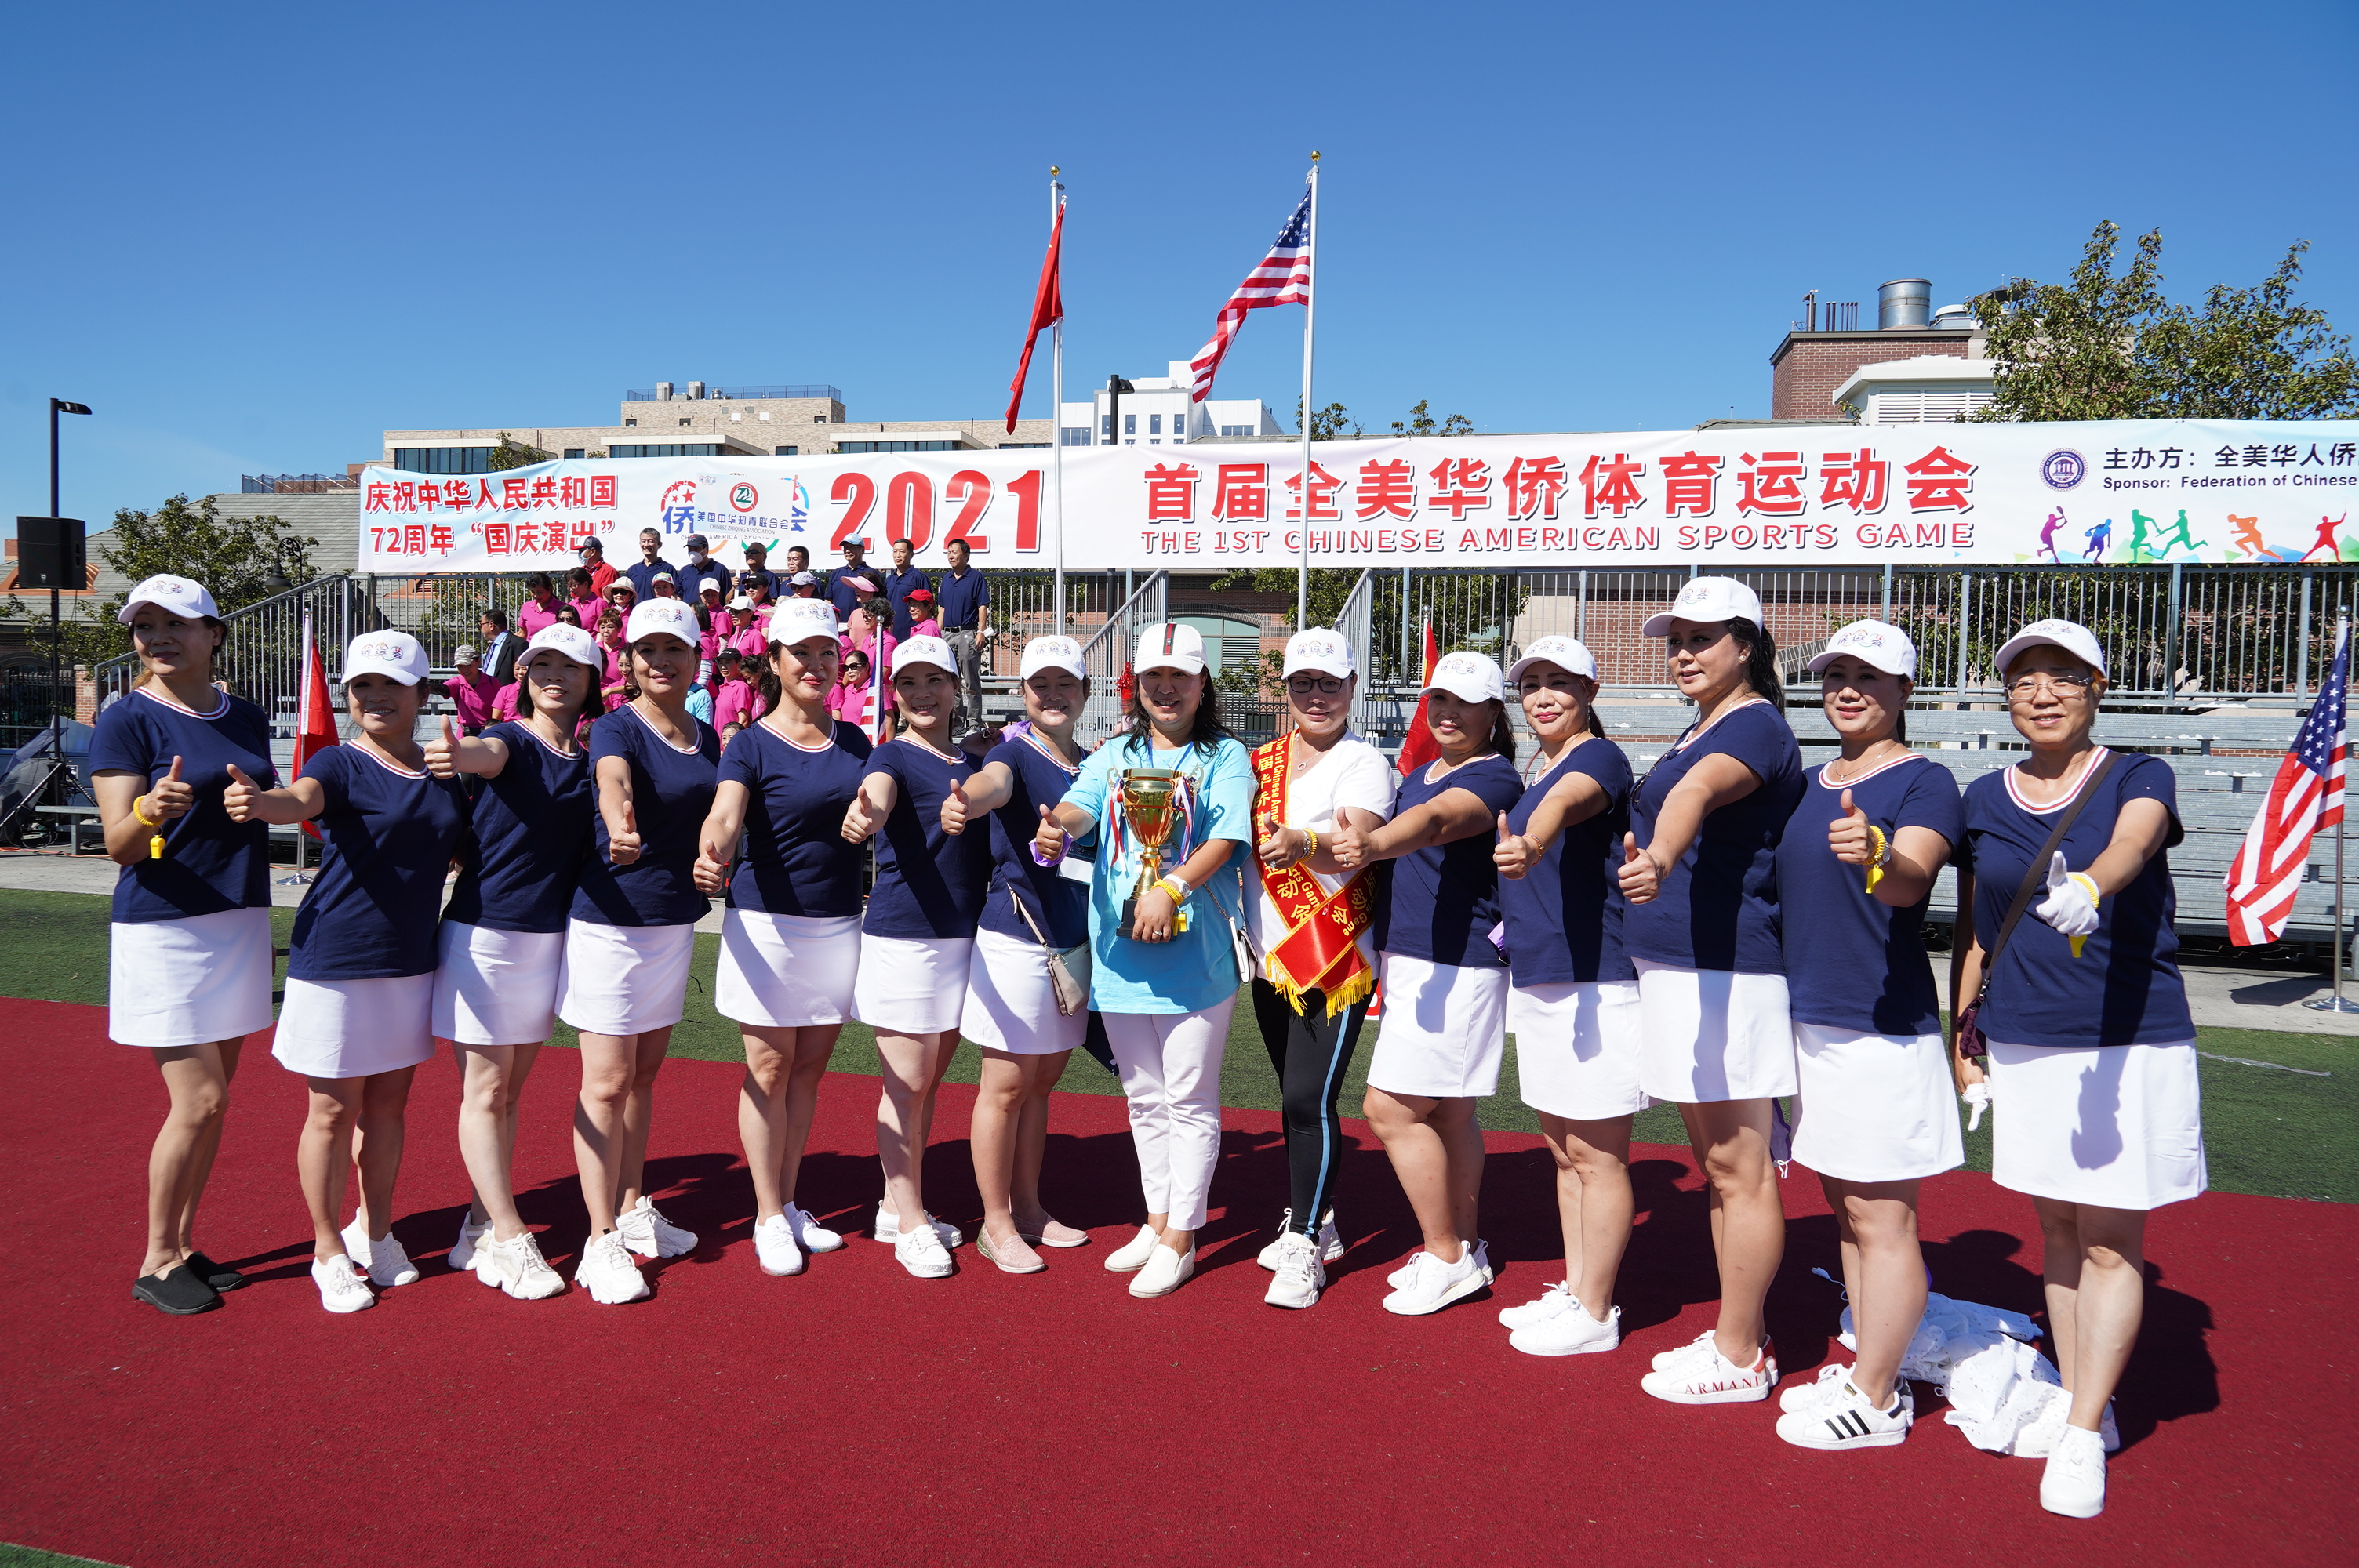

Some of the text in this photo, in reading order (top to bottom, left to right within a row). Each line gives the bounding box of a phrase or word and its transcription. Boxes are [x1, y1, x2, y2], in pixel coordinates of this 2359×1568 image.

[365, 474, 618, 513] 庆祝中华人民共和国
[1144, 445, 1974, 523] 首届全美华侨体育运动会
[2103, 474, 2357, 492] Sponsor: Federation of Chinese
[697, 511, 789, 530] 美国中华知青联合会
[829, 470, 1044, 554] 2021
[369, 523, 456, 556] 72周年
[1142, 521, 1974, 553] THE 1ST CHINESE AMERICAN SPORTS GAME
[1276, 735, 1288, 750] The
[1274, 750, 1285, 765] 1st
[1271, 764, 1285, 798] Chinese
[1270, 799, 1281, 826] Amer
[1301, 881, 1321, 909] Gam
[1343, 913, 1368, 937] Game
[1685, 1376, 1759, 1394] ARMANI
